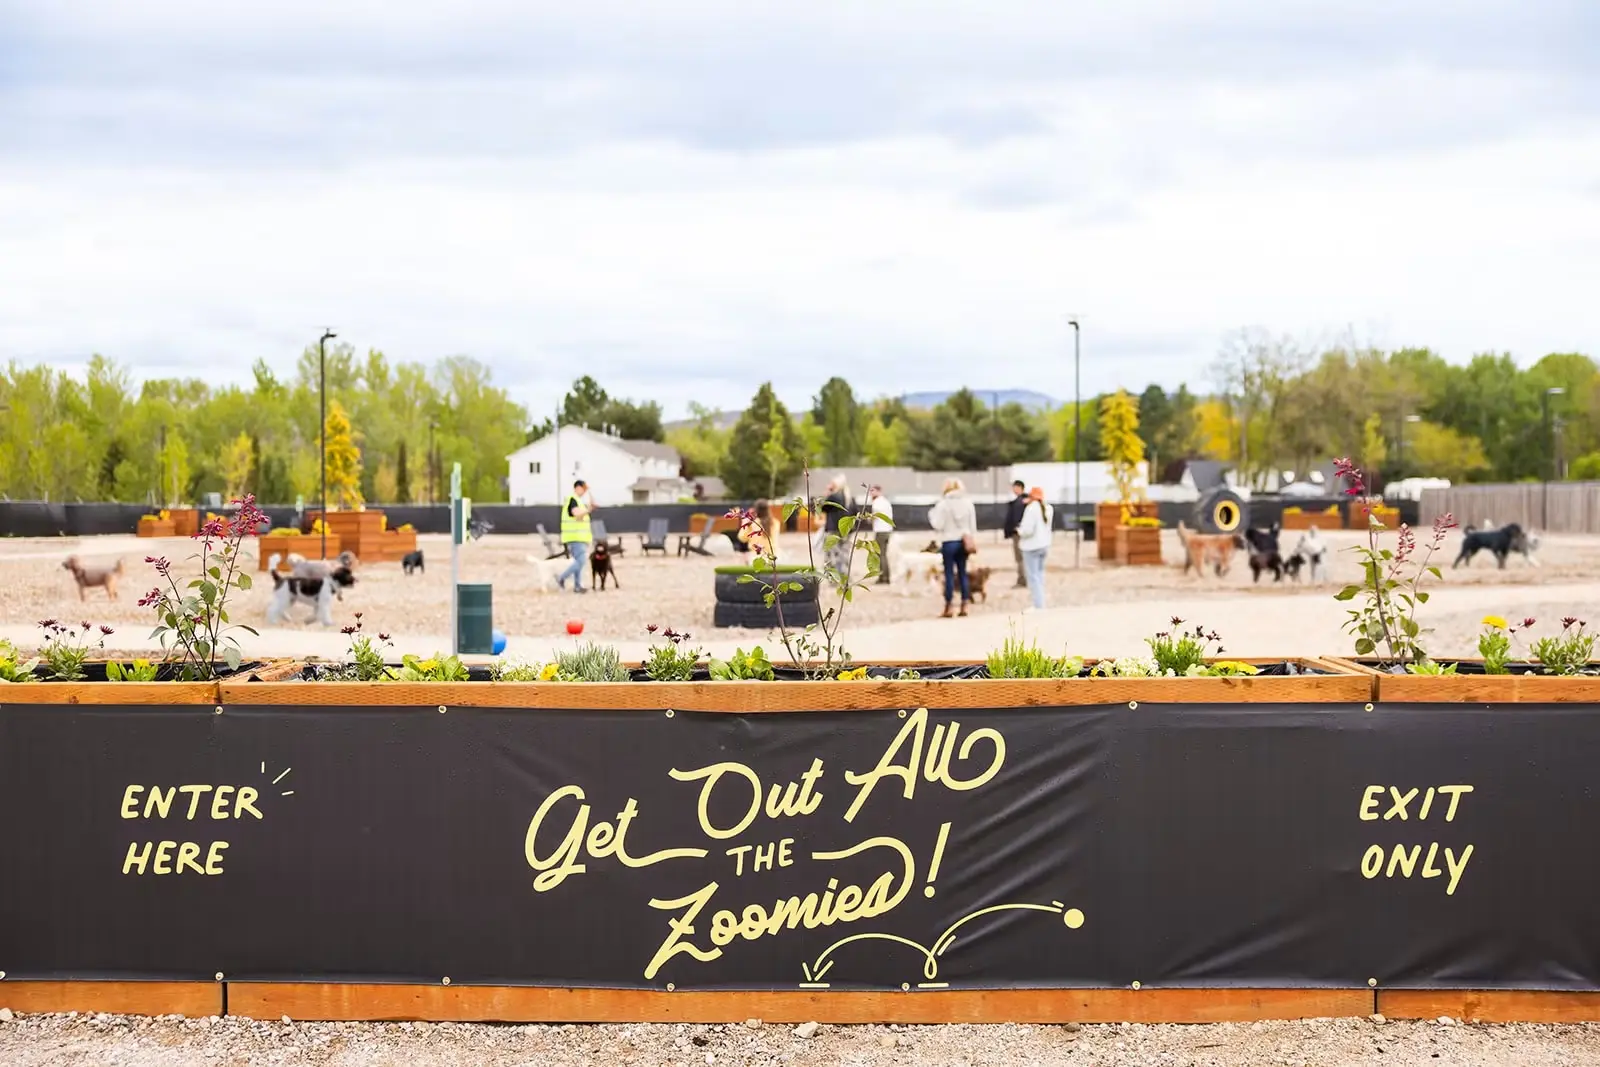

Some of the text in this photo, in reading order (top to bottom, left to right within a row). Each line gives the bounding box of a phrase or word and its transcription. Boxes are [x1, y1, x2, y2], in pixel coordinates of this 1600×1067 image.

[120, 784, 264, 821] ENTER
[524, 707, 1006, 892] Get Out All
[1359, 784, 1474, 822] EXIT
[122, 840, 230, 876] HERE
[725, 837, 795, 877] THE
[1360, 841, 1474, 896] ONLY
